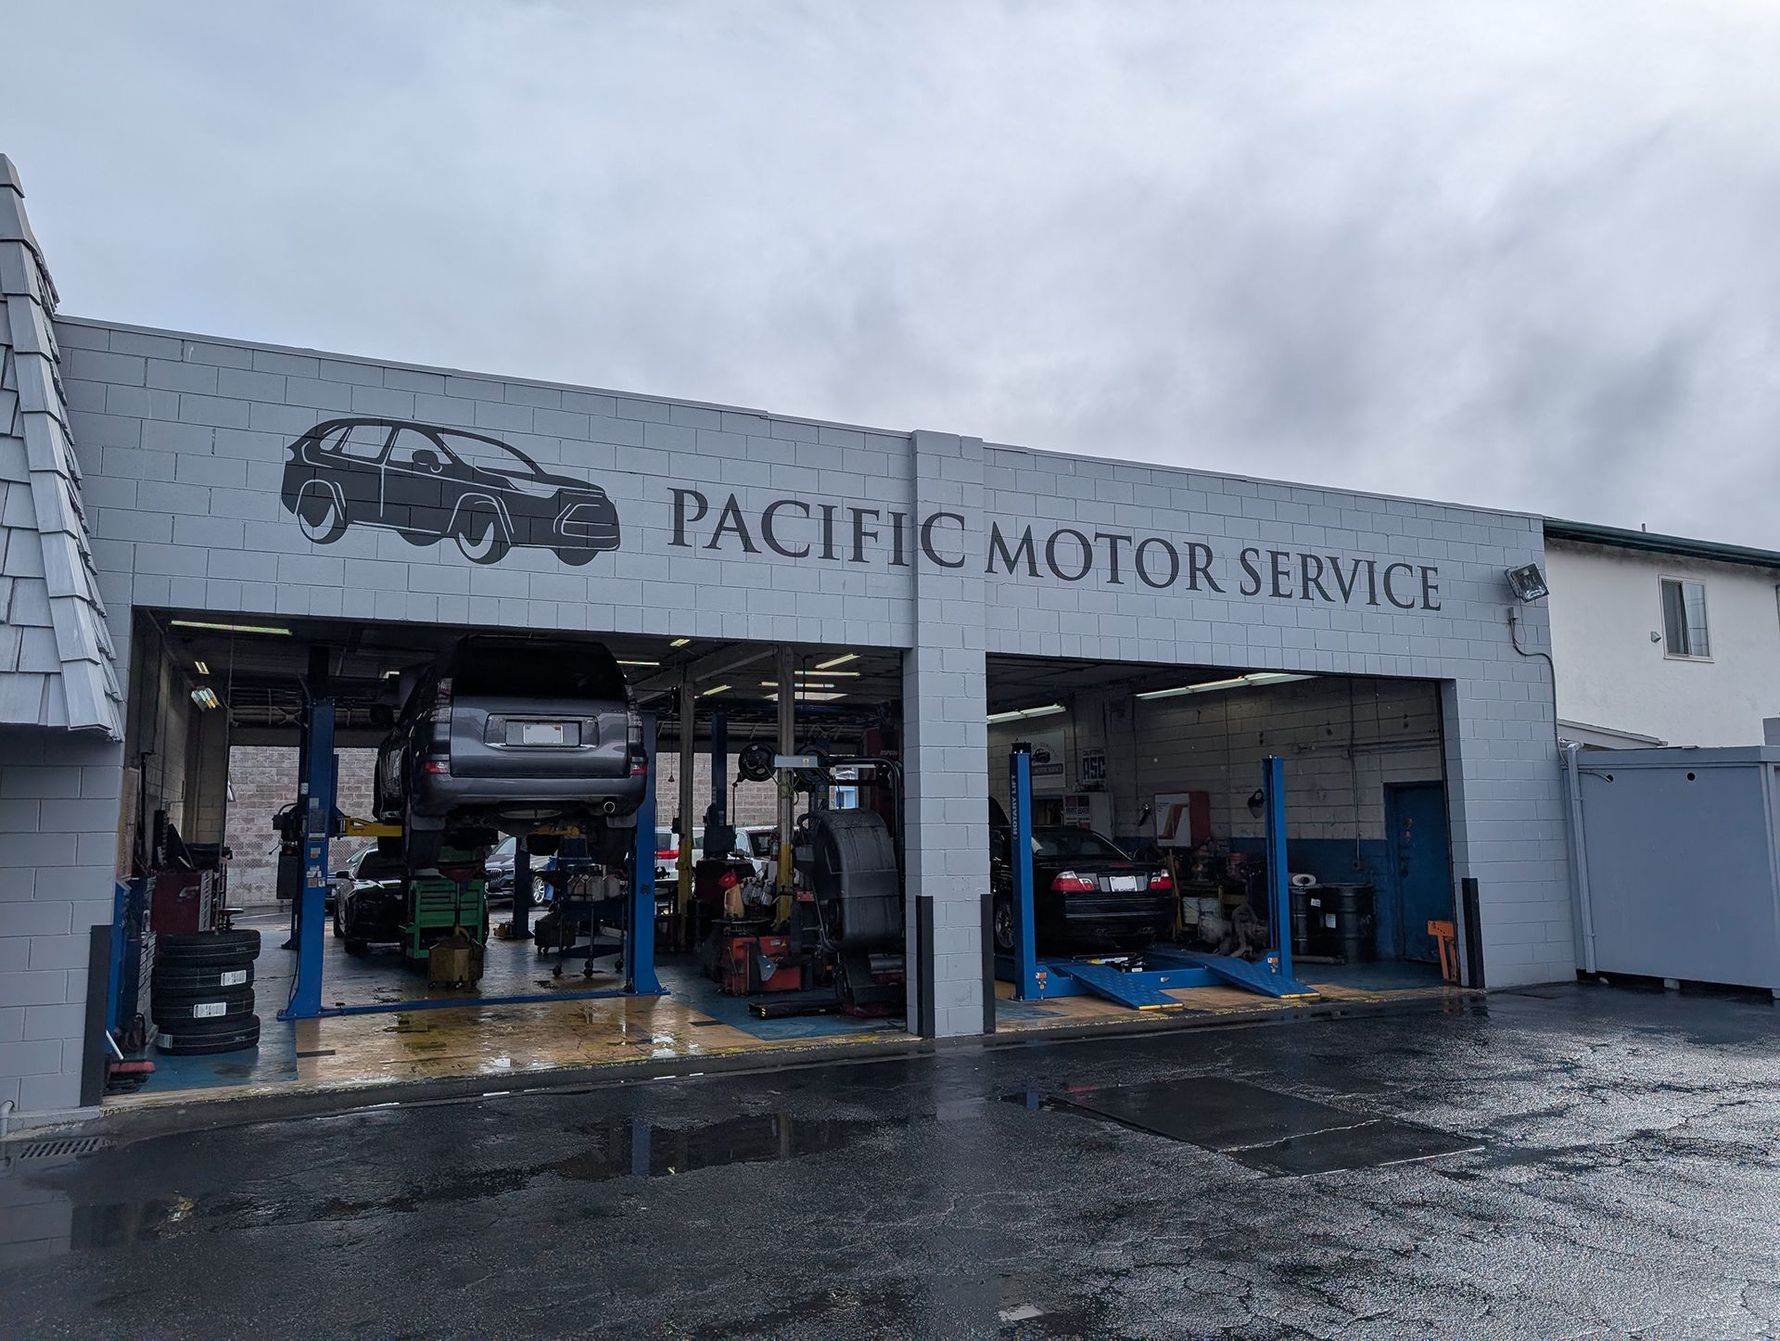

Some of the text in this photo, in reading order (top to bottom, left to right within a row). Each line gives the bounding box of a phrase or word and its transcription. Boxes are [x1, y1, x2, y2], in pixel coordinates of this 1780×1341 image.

[667, 487, 1442, 612] PACIFIC MOTOR SERVICE
[1083, 756, 1106, 779] ASC
